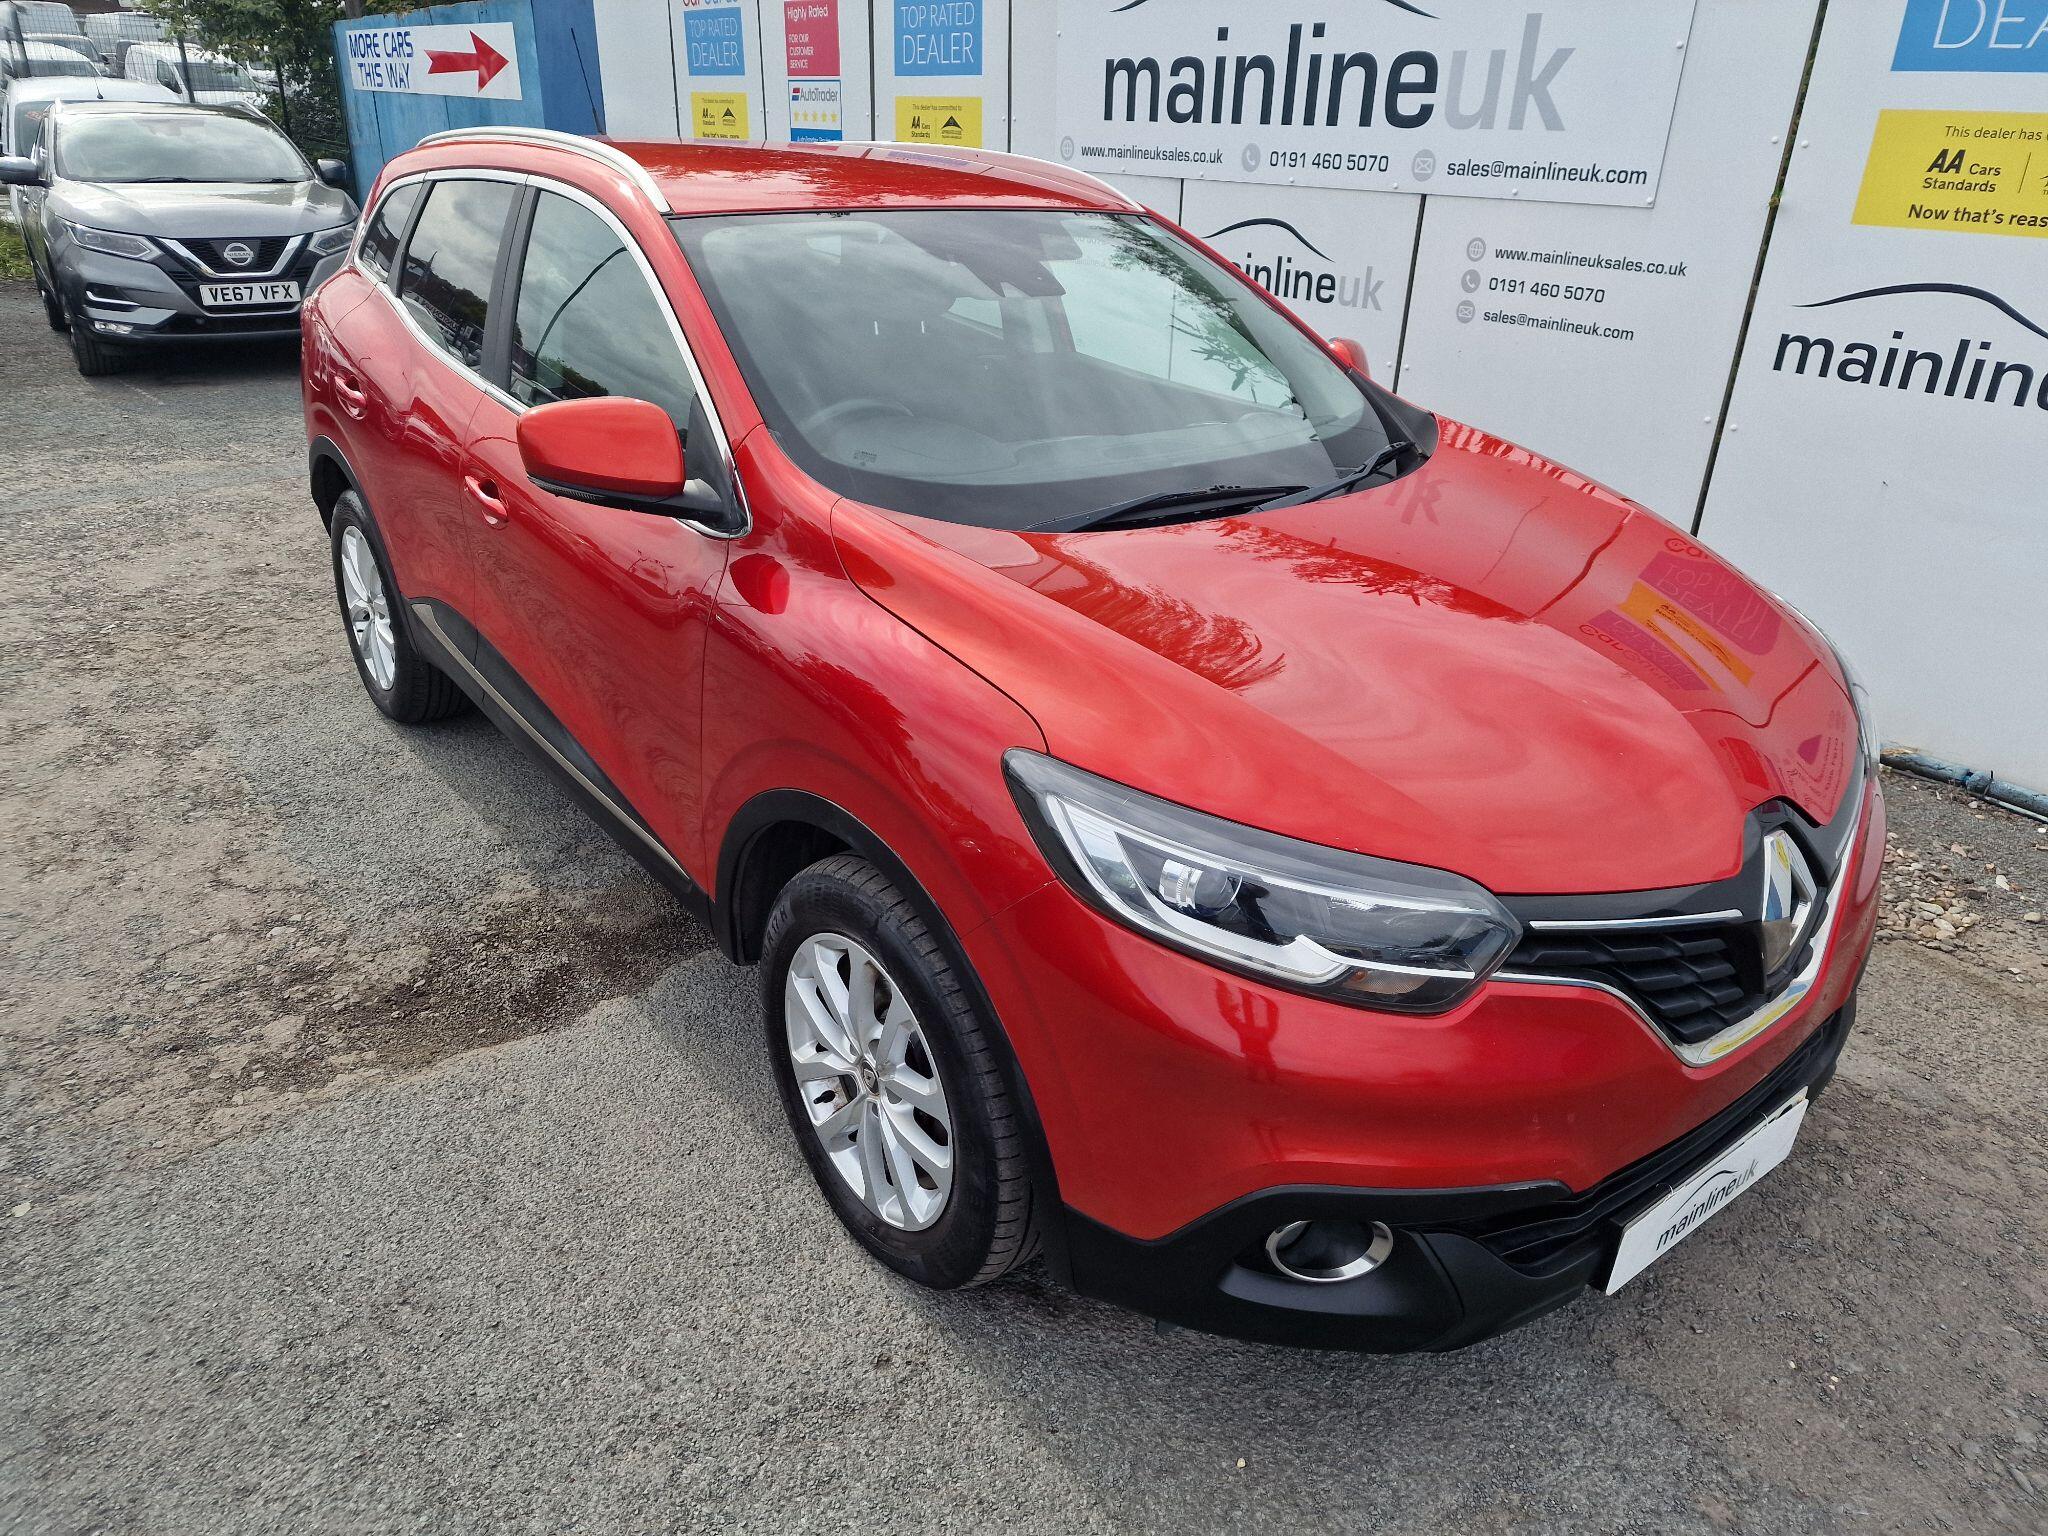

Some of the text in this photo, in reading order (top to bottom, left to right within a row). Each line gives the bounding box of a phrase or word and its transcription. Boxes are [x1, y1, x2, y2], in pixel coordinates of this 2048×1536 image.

[808, 4, 829, 17] Rated
[900, 2, 975, 28] TOP RATED
[689, 17, 738, 37] TOP RATED
[789, 34, 799, 43] FOR
[349, 31, 414, 58] MORE CARS
[691, 41, 740, 67] DEALER
[902, 32, 974, 64] DEALER
[357, 62, 410, 88] THIS WAY
[800, 87, 839, 102] AutoTrader
[1945, 126, 2042, 140] This dealer has
[1081, 144, 1648, 185] www.mainlineuksales.co.uk 0191 460 5070 sales@mainlineuk.com
[1926, 148, 2001, 176] AA Cars
[1922, 177, 1996, 193] Standards
[1907, 203, 1949, 219] Now
[1953, 206, 2004, 224] that's
[1494, 248, 1688, 277] www.mainlineuksales.co.uk
[207, 284, 293, 302] VE67 VFX
[1488, 277, 1606, 303] 0191 460 5070
[1483, 310, 1635, 341] sales@mainlineuk.com
[1655, 1159, 1760, 1251] mainlineuk
